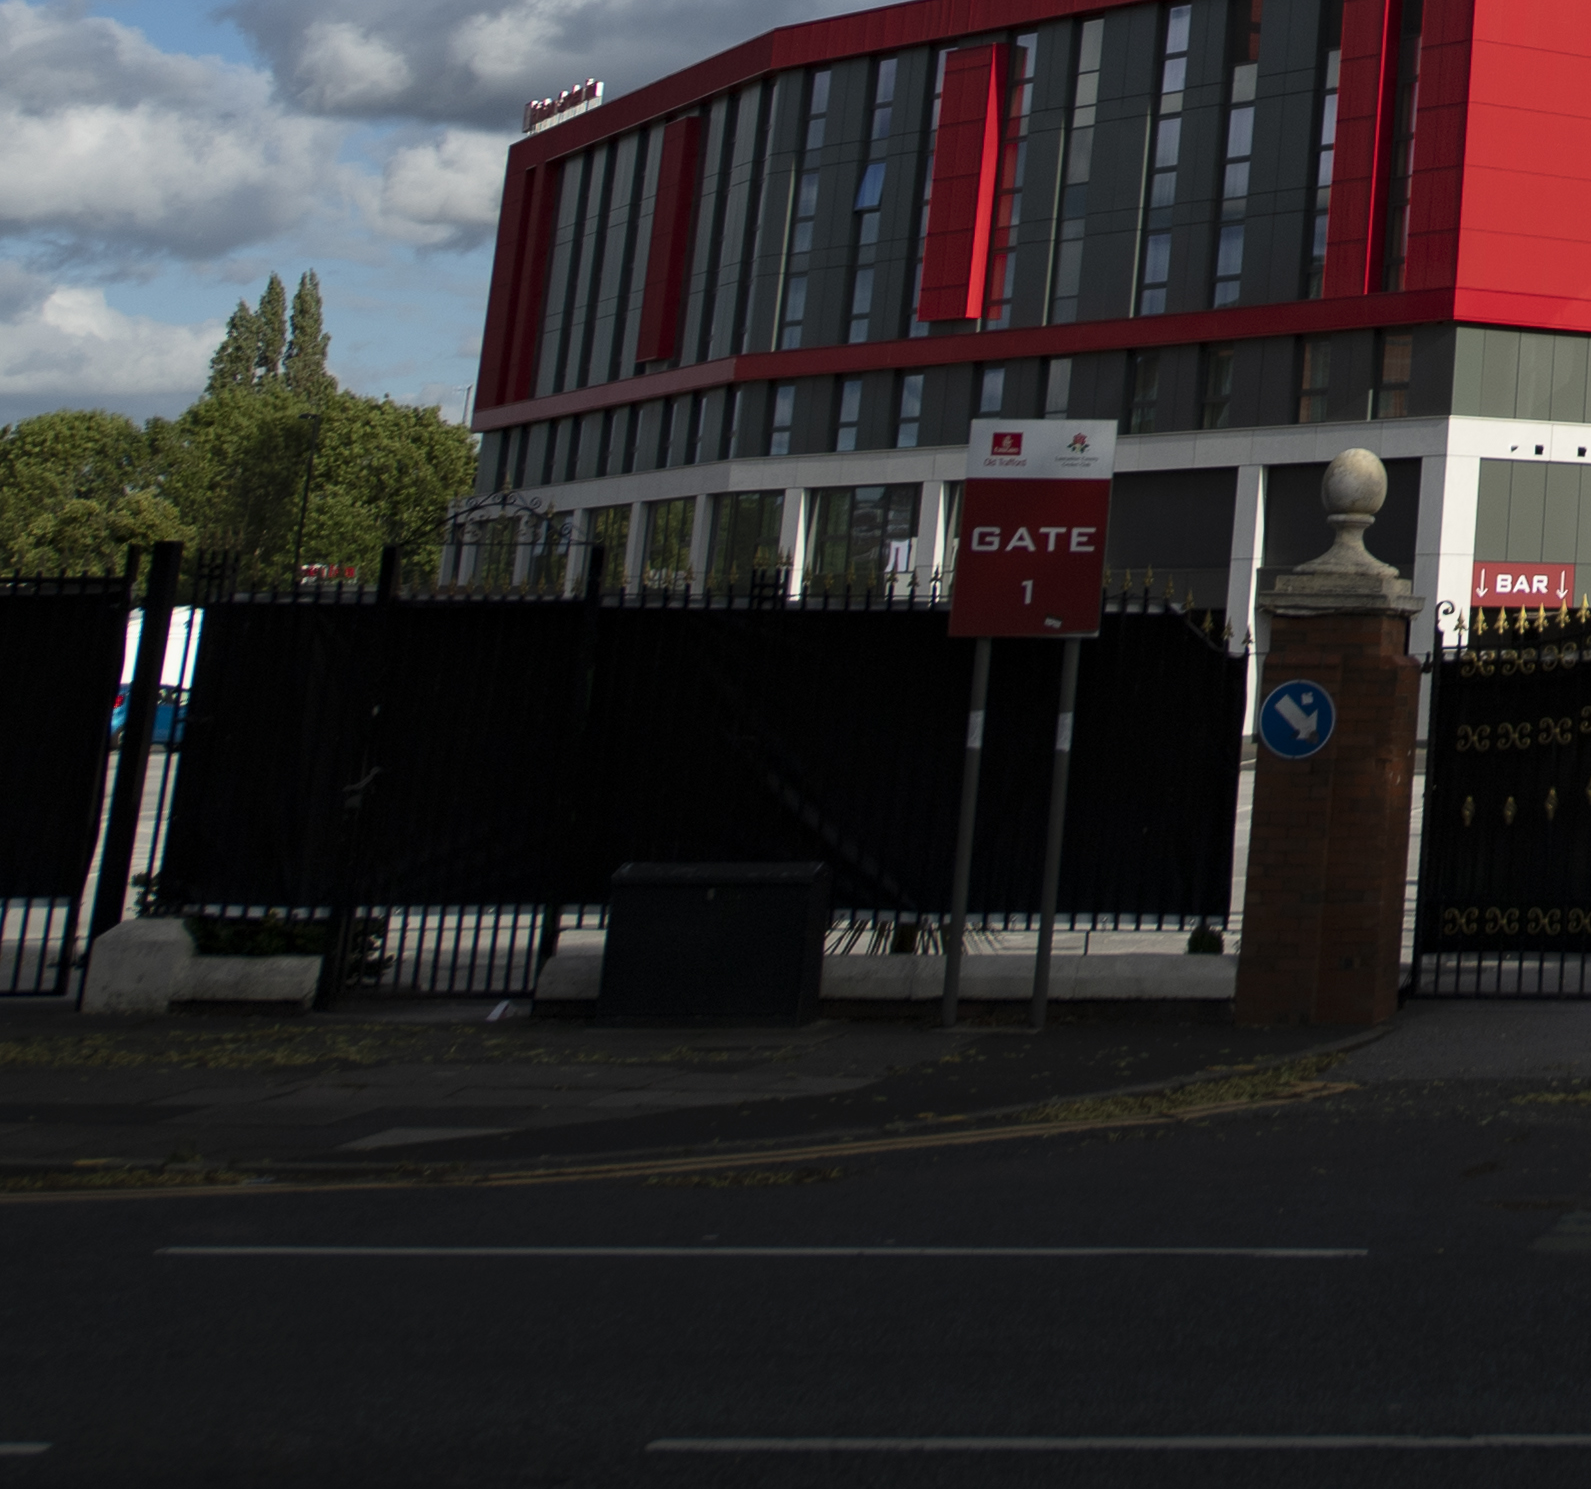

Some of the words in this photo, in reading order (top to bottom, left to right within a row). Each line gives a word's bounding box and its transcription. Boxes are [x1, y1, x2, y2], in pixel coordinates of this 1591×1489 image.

[970, 526, 1097, 552] GATE
[1021, 579, 1034, 605] 1
[1495, 574, 1548, 594] BAR
